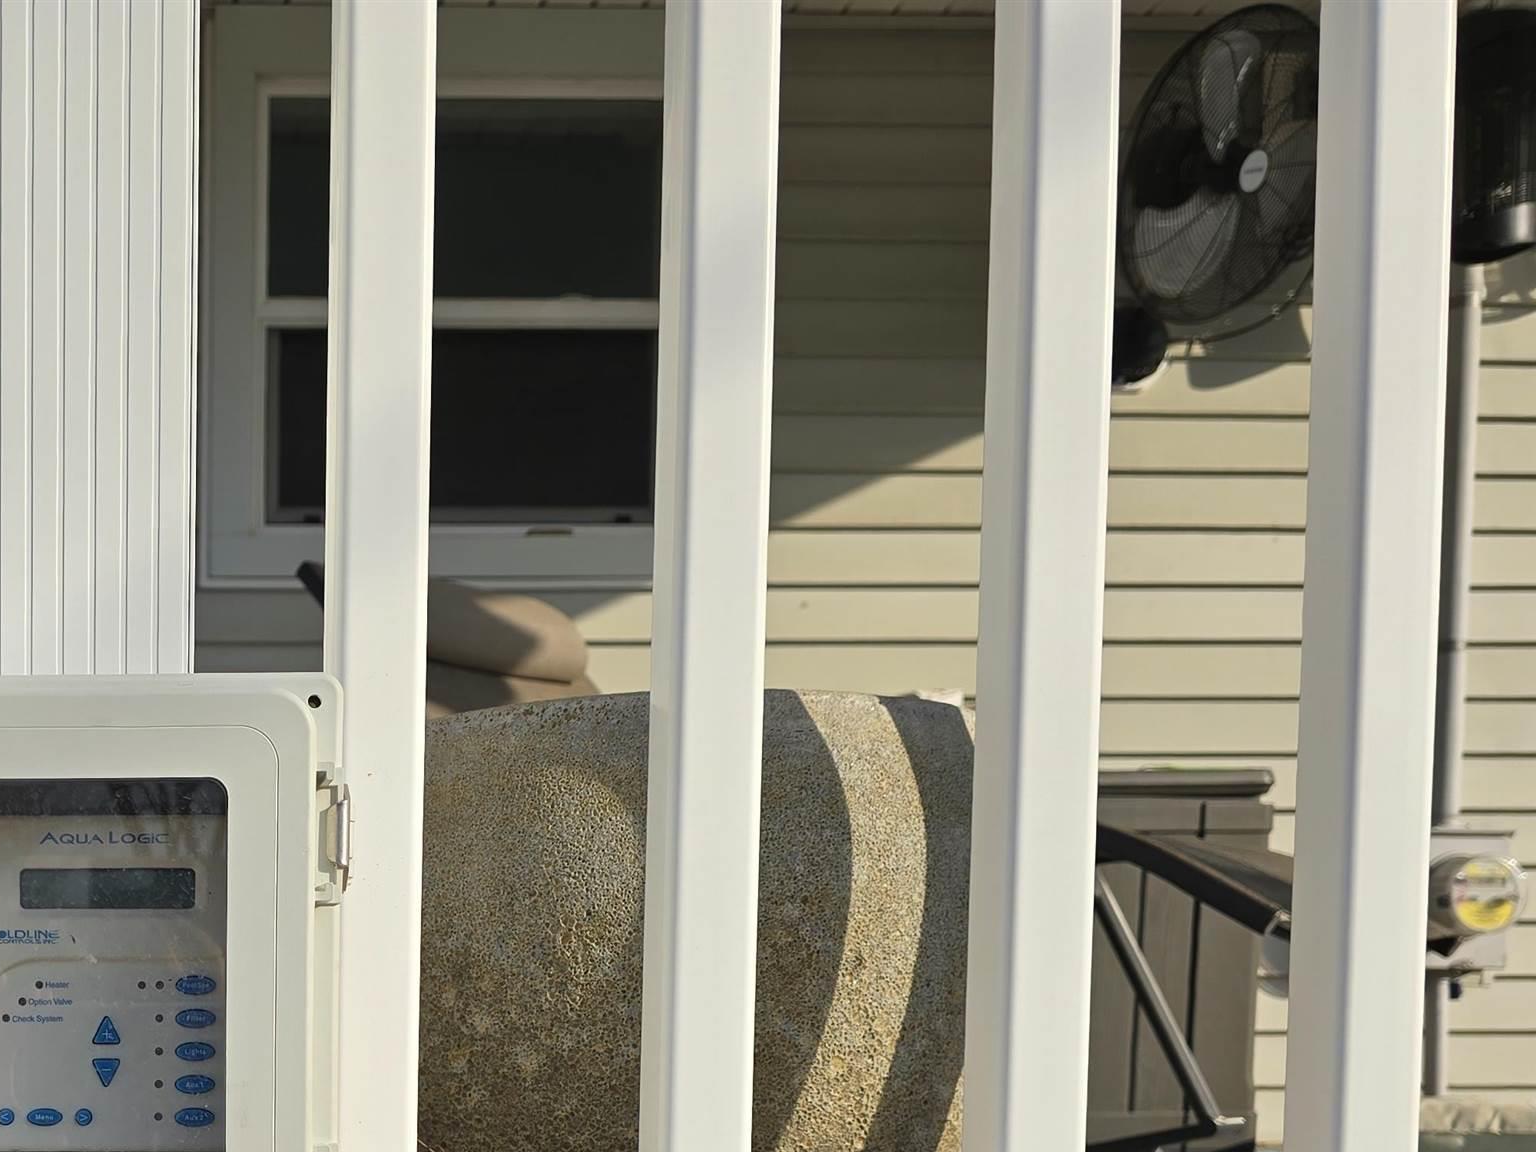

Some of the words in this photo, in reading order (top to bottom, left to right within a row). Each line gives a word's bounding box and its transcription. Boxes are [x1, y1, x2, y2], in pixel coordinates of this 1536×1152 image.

[40, 832, 104, 845] AQUA
[109, 831, 169, 844] LOGIC
[12, 1015, 35, 1023] Check
[36, 1015, 64, 1024] System
[185, 1047, 207, 1056] Lights
